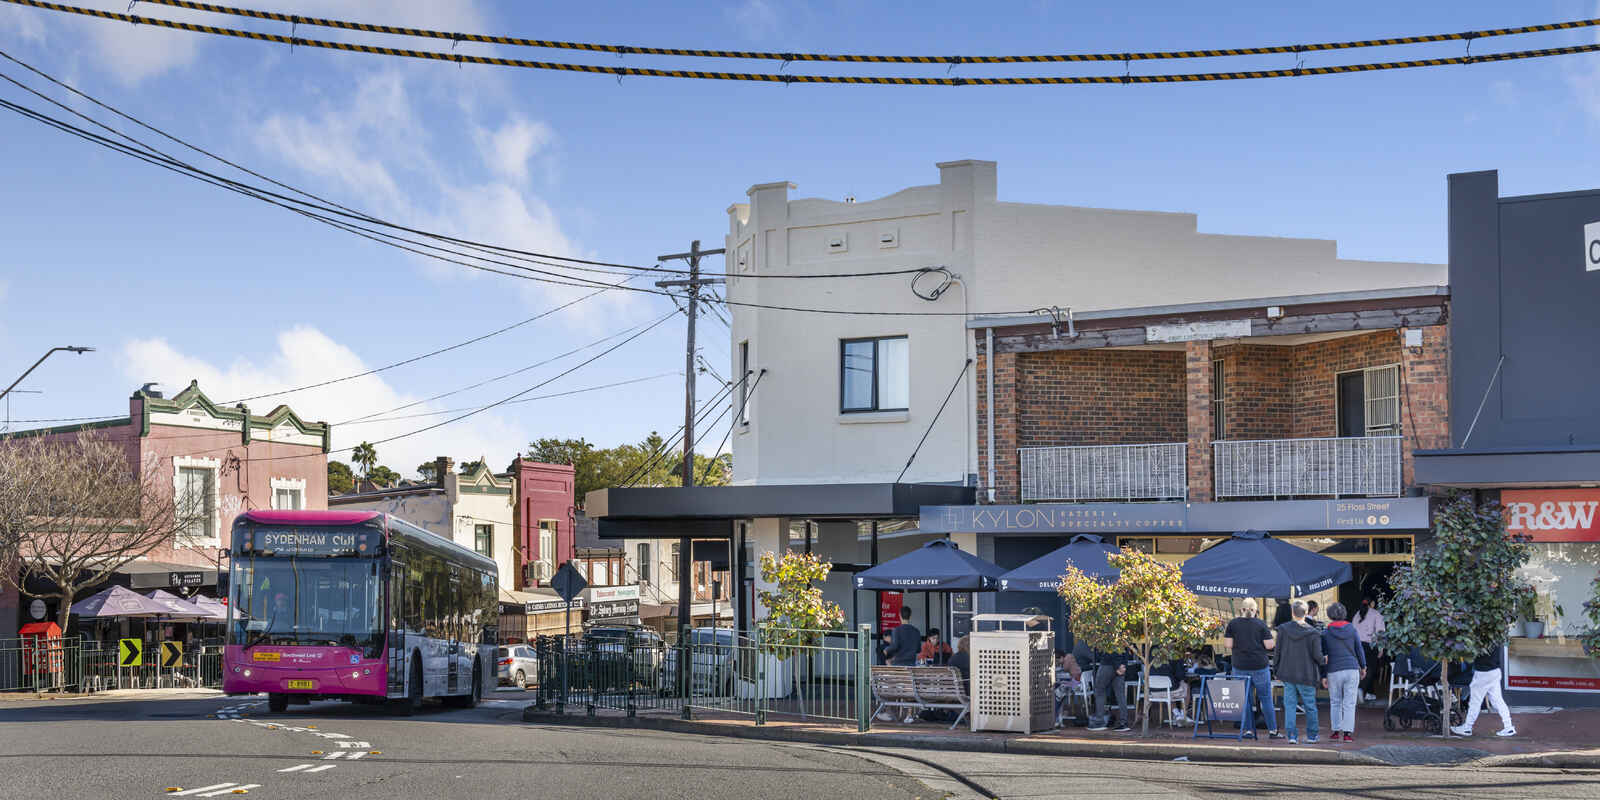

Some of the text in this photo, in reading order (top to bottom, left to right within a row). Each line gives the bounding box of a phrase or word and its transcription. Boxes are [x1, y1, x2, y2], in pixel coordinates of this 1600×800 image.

[1336, 503, 1346, 512] 25
[1366, 502, 1390, 512] Street
[972, 509, 1055, 528] KYLON
[1506, 501, 1598, 530] R&W
[1060, 519, 1183, 528] SPECIALTY COFFEE
[264, 534, 326, 545] SYDENHAM
[1196, 584, 1249, 595] DELUCA COFFEE
